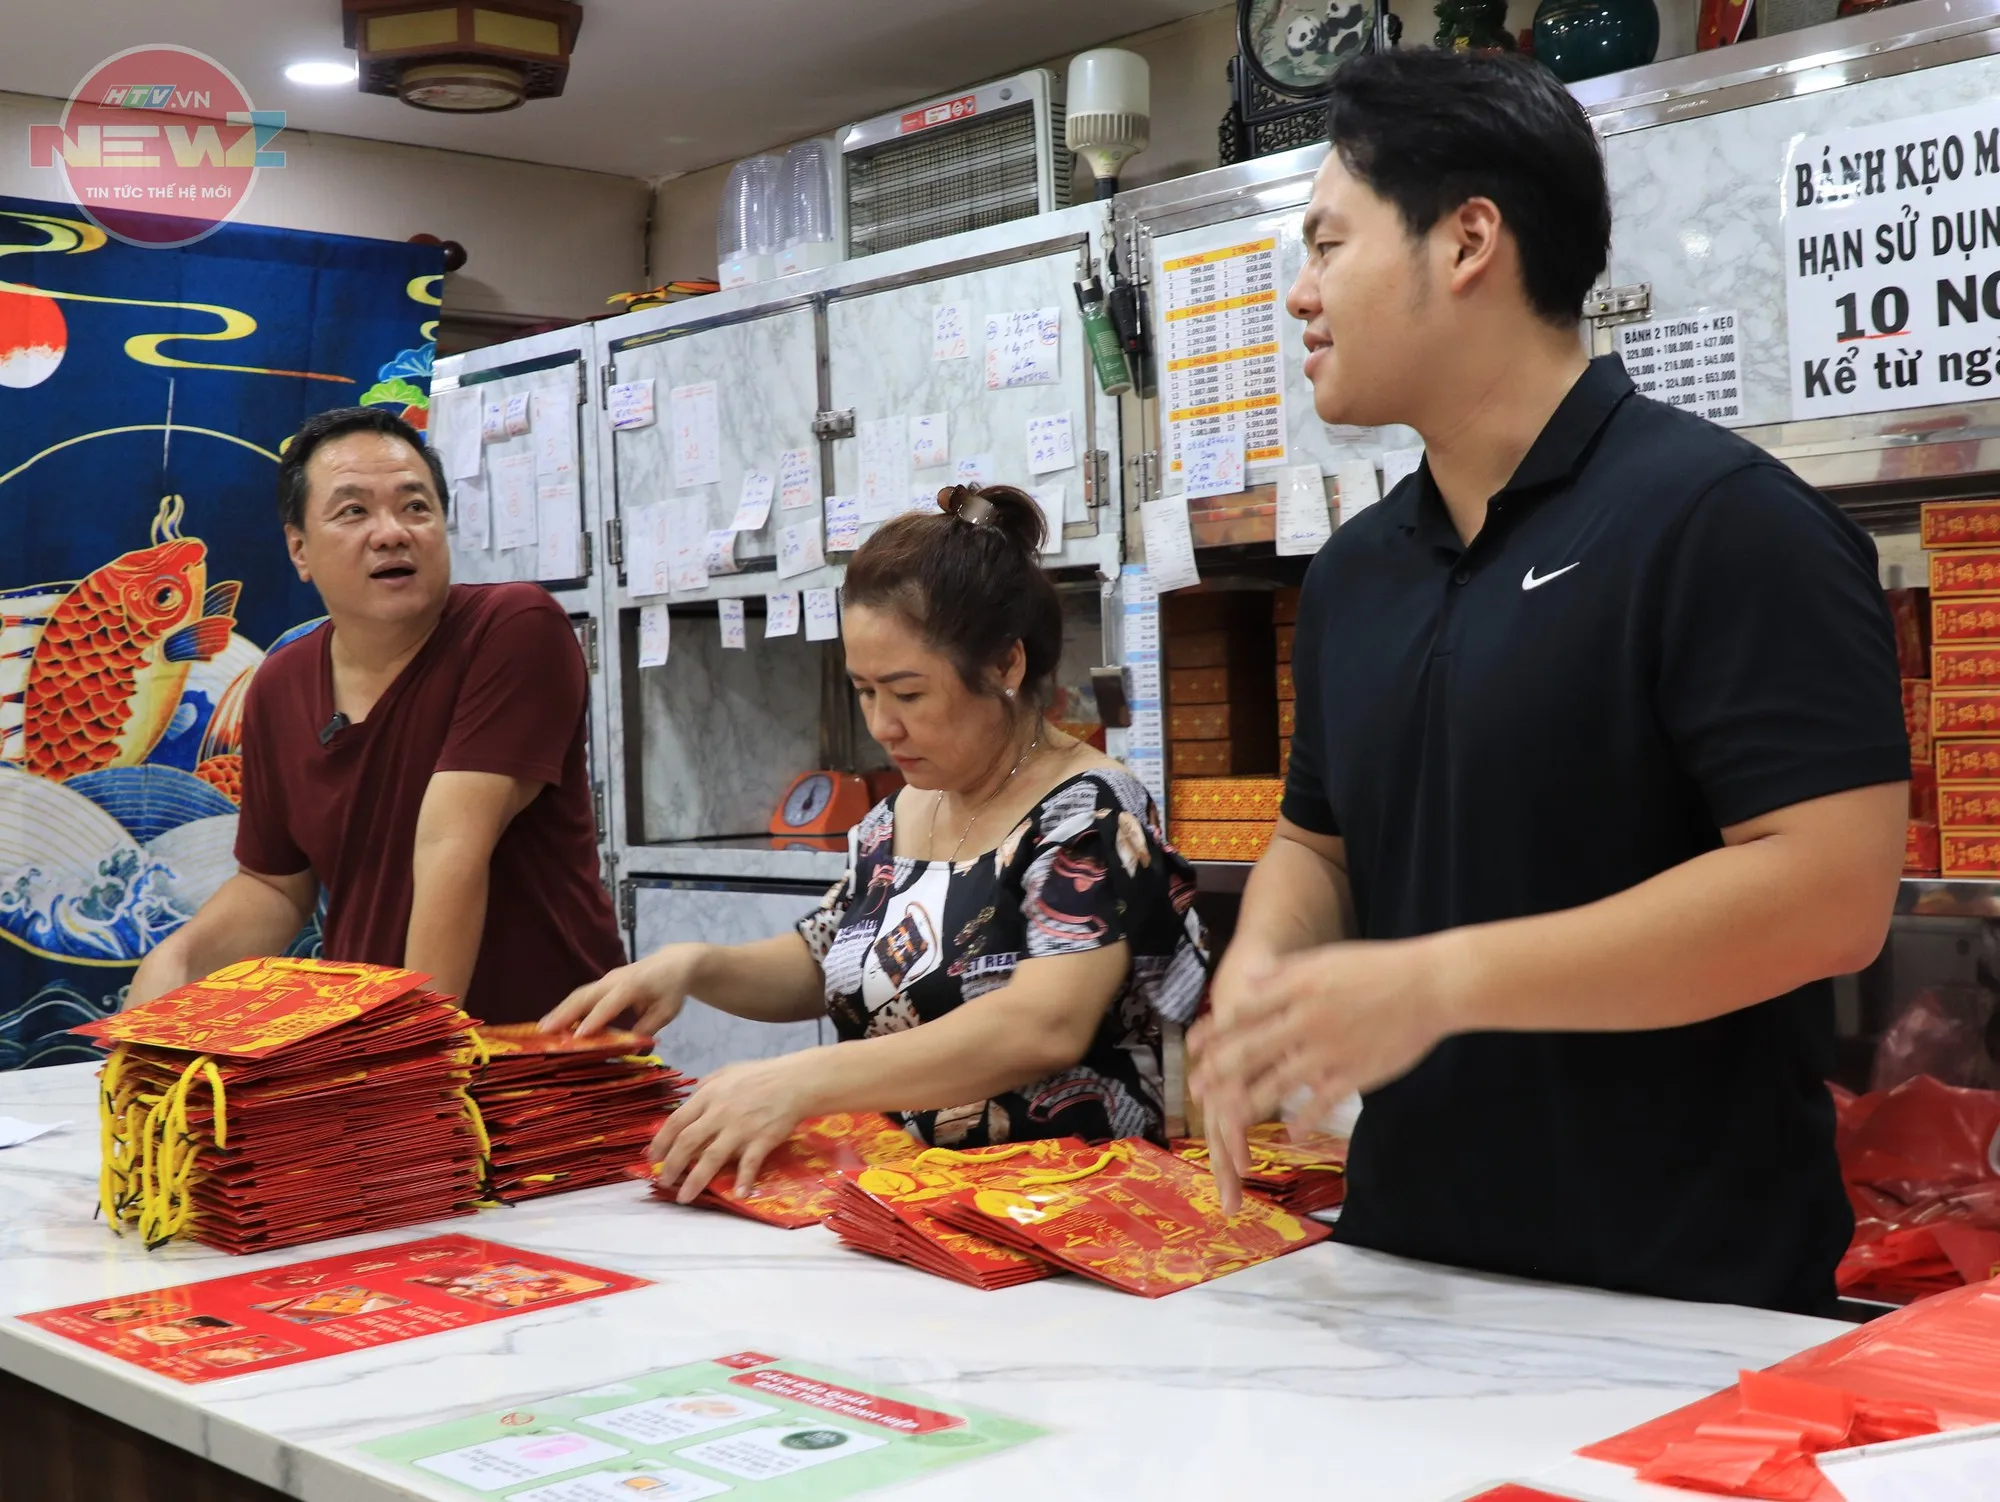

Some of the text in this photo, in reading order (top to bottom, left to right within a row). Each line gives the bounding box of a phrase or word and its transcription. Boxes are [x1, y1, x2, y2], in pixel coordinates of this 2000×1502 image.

[1795, 145, 1886, 207] BÁNH
[1896, 135, 1964, 195] KẸO
[1798, 228, 1863, 281] HẠN
[1876, 204, 1920, 265] SỬ
[1625, 328, 1651, 344] BÁNH
[1654, 327, 1661, 339] 2
[1713, 316, 1733, 332] KẸO
[1835, 285, 1910, 341] 10
[1804, 346, 1860, 398] Kể
[1874, 348, 1923, 389] từ
